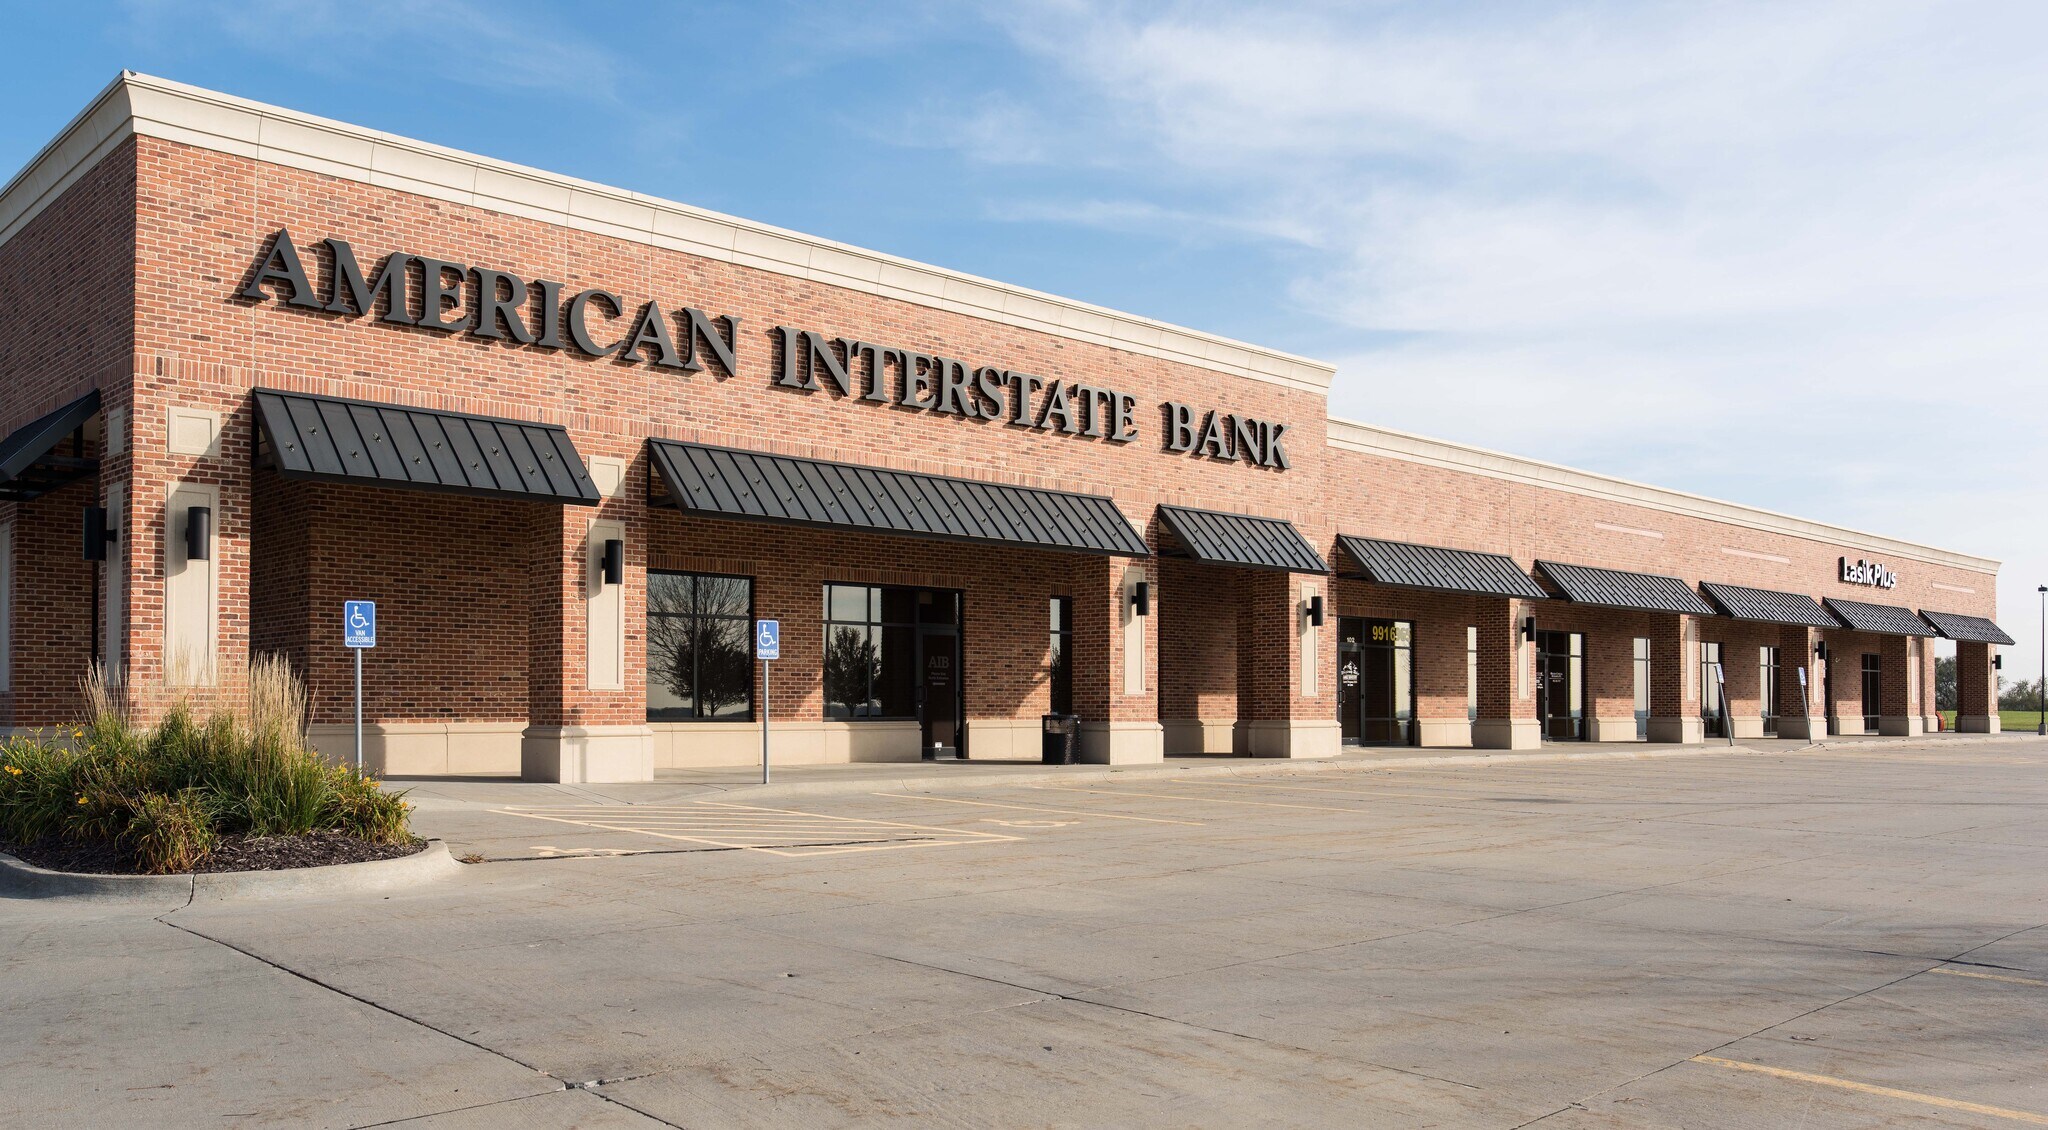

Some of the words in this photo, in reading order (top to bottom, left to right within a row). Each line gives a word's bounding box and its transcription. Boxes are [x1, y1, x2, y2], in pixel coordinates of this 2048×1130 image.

[242, 228, 742, 378] AMERICAN
[776, 325, 1139, 443] INTERSTATE
[1166, 401, 1292, 470] BANK
[1840, 556, 1897, 588] LasikPlus
[928, 655, 950, 668] AIB
